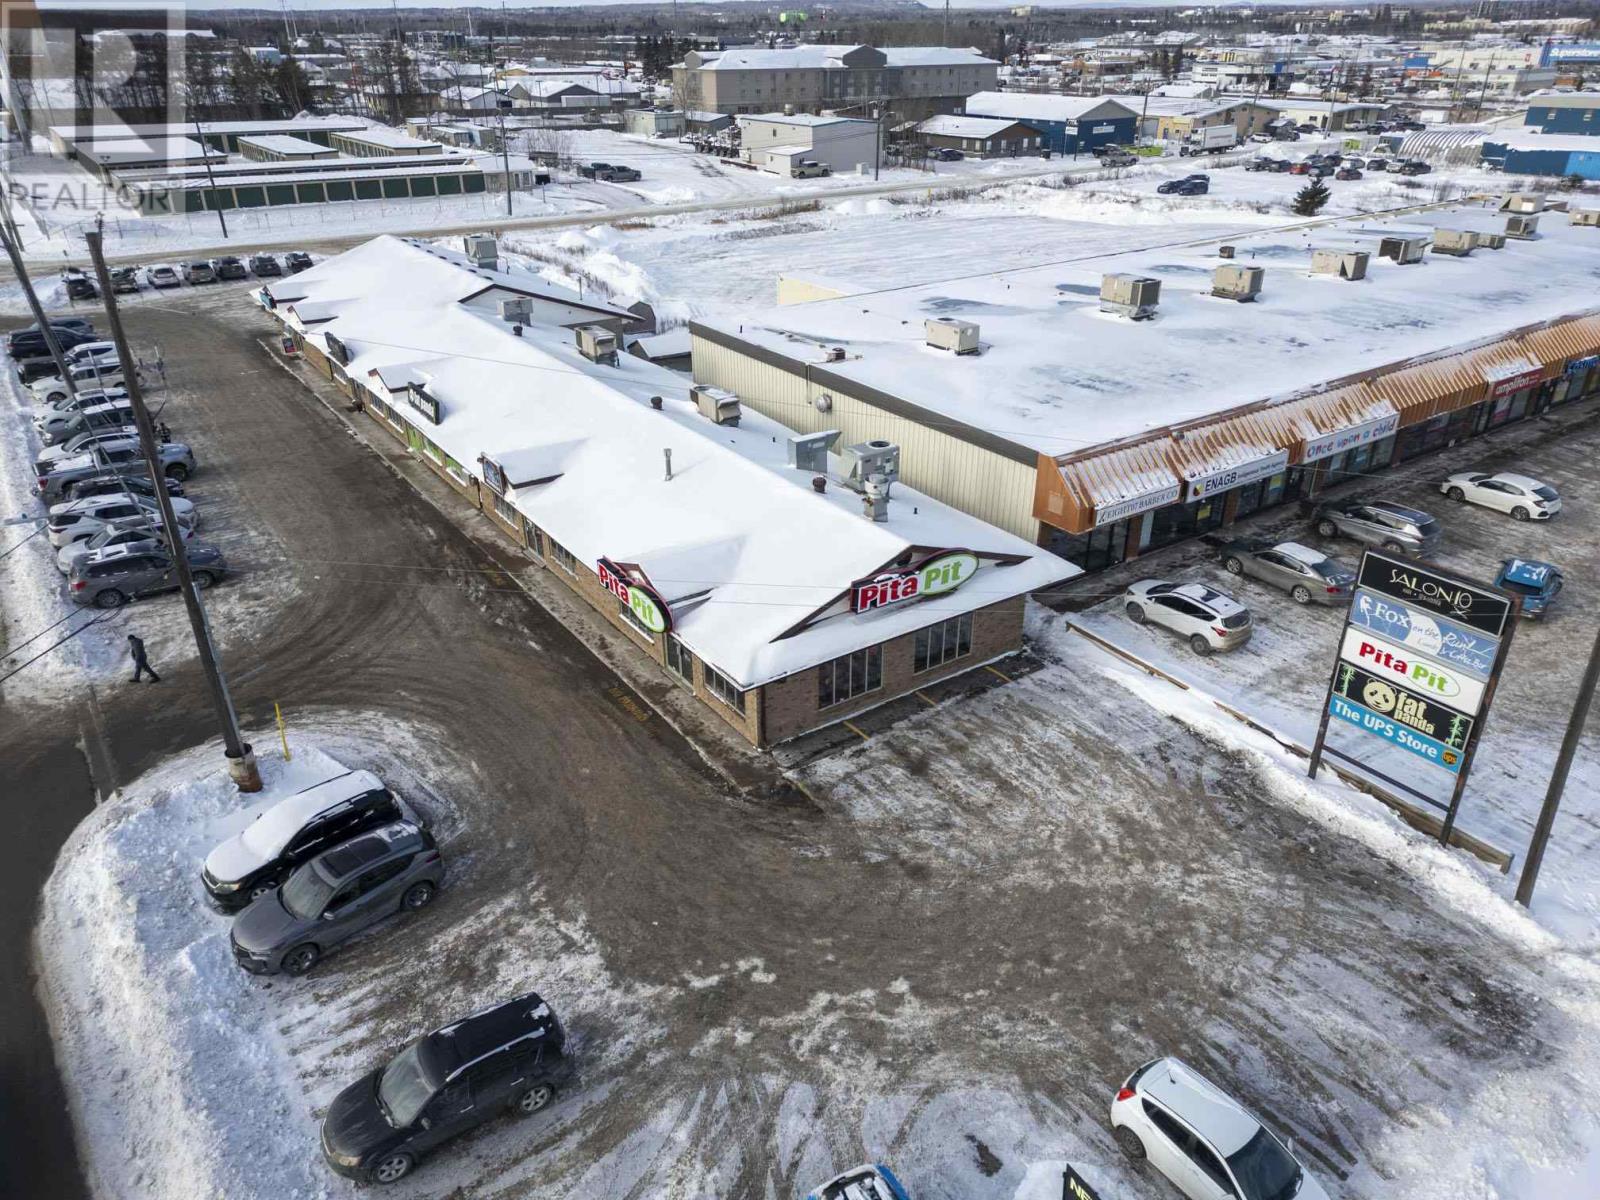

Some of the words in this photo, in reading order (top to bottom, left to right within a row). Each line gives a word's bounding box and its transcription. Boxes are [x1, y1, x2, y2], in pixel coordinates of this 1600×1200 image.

[1205, 471, 1237, 492] ENAGB
[597, 562, 630, 606] Pita
[631, 591, 655, 626] Pit
[859, 576, 919, 611] Pita
[924, 560, 962, 591] Pit
[1359, 641, 1408, 675] Pita
[1411, 664, 1449, 692] Pit
[1335, 700, 1361, 722] The
[1364, 714, 1395, 737] UPS
[1396, 730, 1438, 758] Store
[1393, 709, 1435, 734] panda
[1396, 692, 1428, 720] fat
